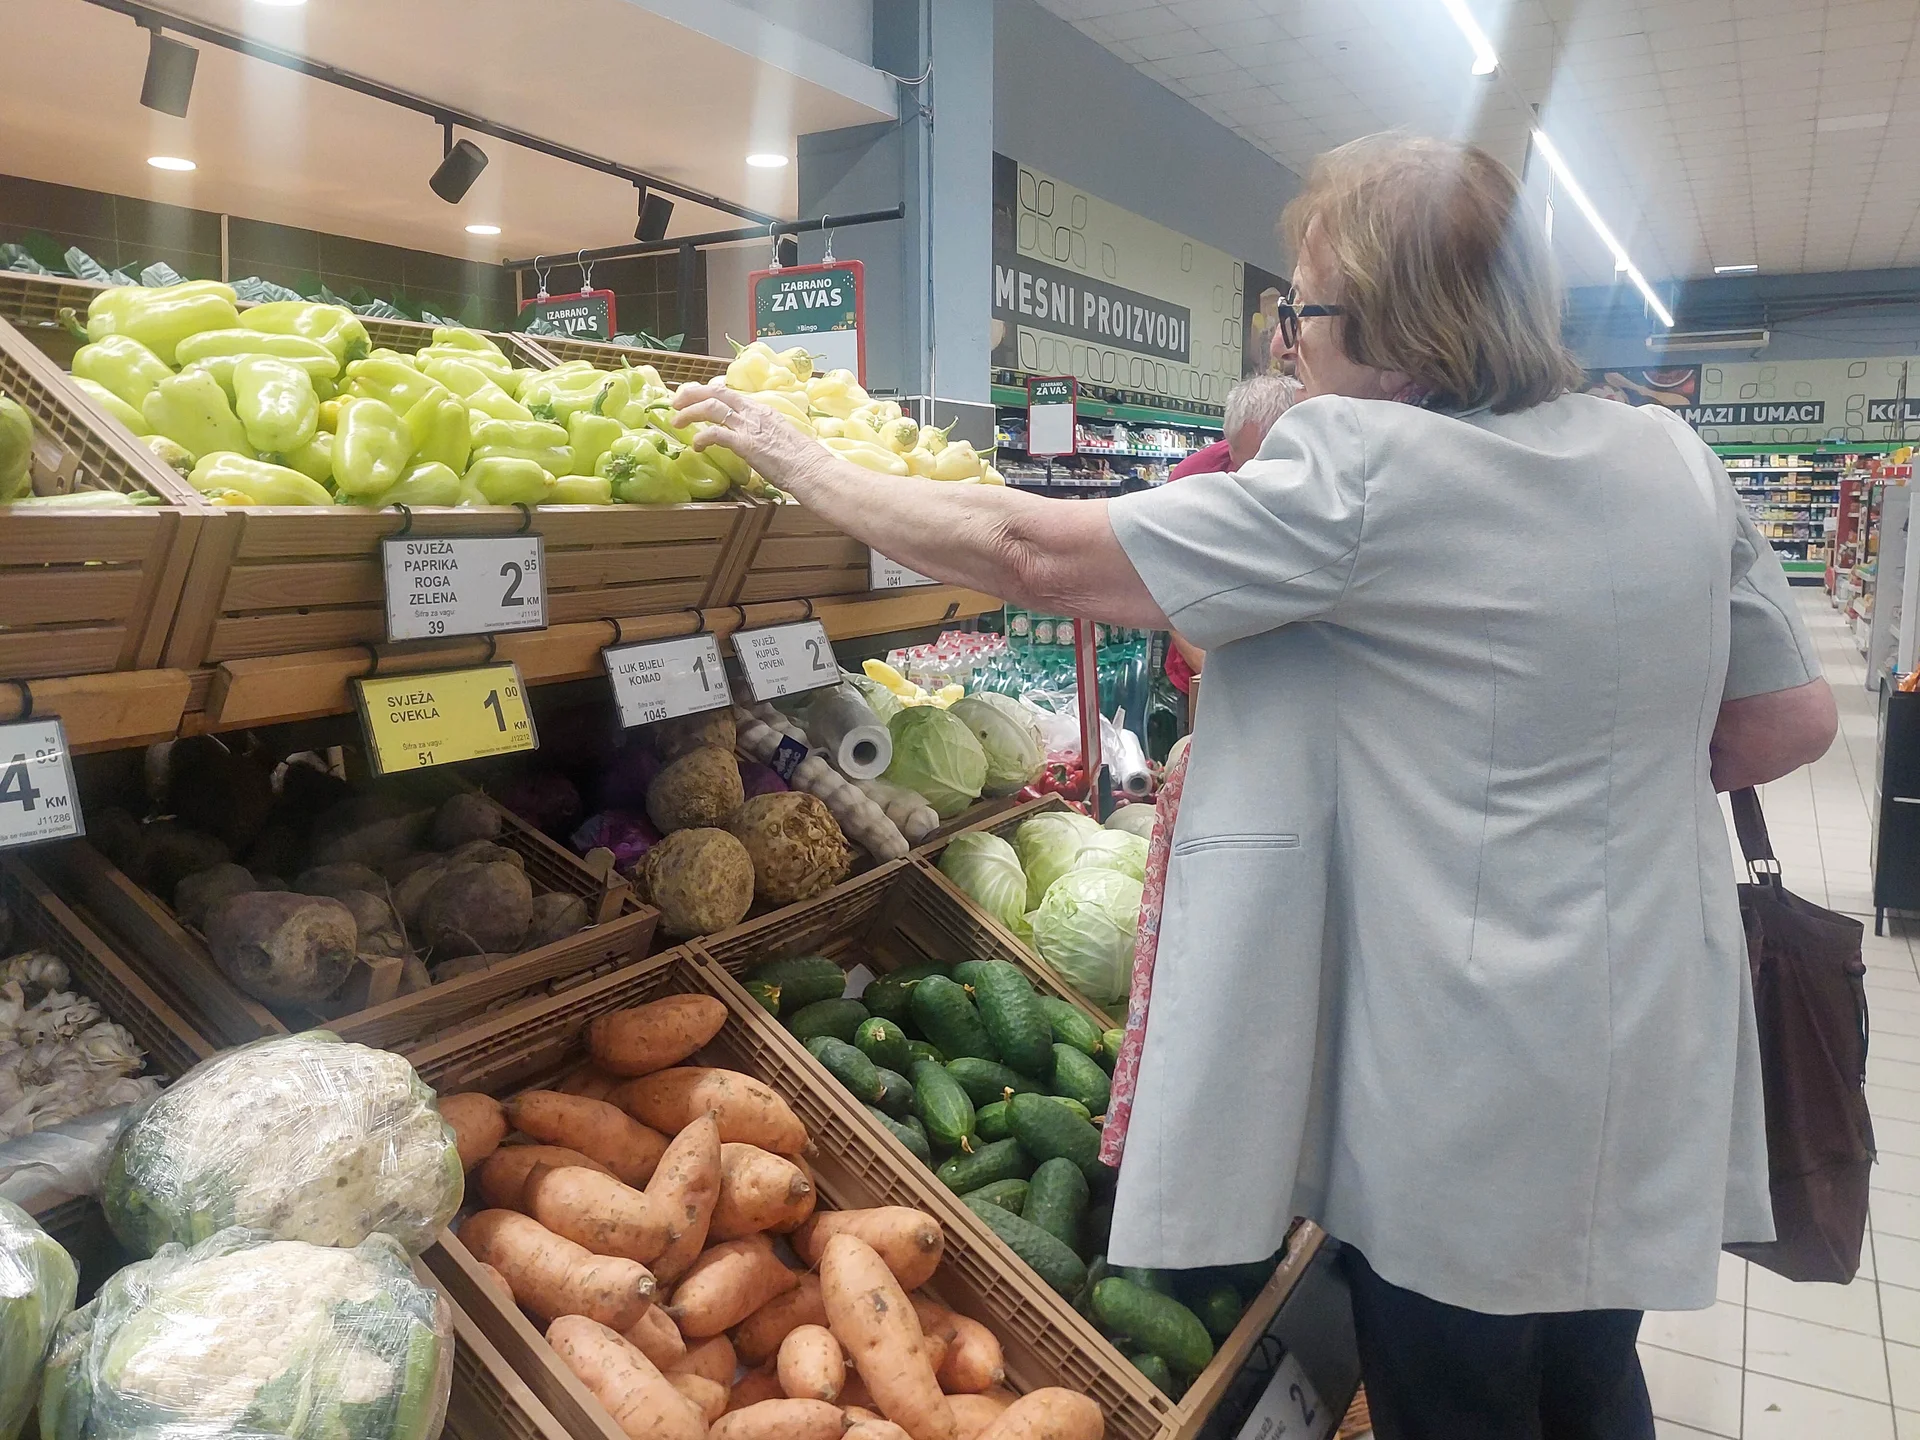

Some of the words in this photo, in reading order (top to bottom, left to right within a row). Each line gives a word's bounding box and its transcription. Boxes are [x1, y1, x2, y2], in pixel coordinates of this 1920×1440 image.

[781, 278, 832, 292] IZABRANO
[771, 292, 799, 312] ZA
[801, 288, 842, 309] VAS
[546, 307, 589, 320] IZABRANO
[995, 264, 1075, 327] MESNI
[1083, 291, 1186, 353] PROIZVODI
[564, 316, 598, 334] VAS
[1036, 387, 1048, 395] ZA
[1050, 386, 1067, 395] VAS
[1741, 407, 1746, 422] I
[1753, 405, 1820, 422] UMACI
[407, 540, 454, 555] SVJEŽA
[405, 559, 458, 572] PAPRIKA
[524, 560, 537, 571] 95
[415, 576, 450, 588] ROGA
[500, 562, 524, 607] 2
[886, 576, 901, 586] 1041
[409, 592, 457, 605] ZELENA
[527, 597, 539, 605] KM
[428, 621, 445, 635] 39
[751, 634, 776, 648] SVJEŽI
[755, 647, 780, 659] KUPUS
[805, 639, 826, 671] 2
[817, 636, 826, 645] 20
[619, 662, 637, 674] LUK
[638, 658, 665, 671] BIJELI
[758, 659, 785, 671] CRVENI
[629, 672, 661, 686] KOMAD
[692, 656, 710, 692] 1
[707, 653, 716, 663] 50
[776, 684, 787, 695] 46
[387, 690, 435, 708] SVJEŽA
[390, 707, 440, 724] CVEKLA
[484, 689, 507, 732] 1
[505, 686, 518, 698] 00
[514, 720, 528, 730] KM
[643, 707, 667, 722] 1045
[45, 736, 55, 744] kg
[510, 734, 530, 743] J12212
[36, 748, 58, 764] 95
[418, 751, 434, 765] 51
[0, 753, 41, 811] 4
[45, 796, 68, 809] KM
[37, 813, 71, 826] J11286
[1289, 1383, 1315, 1427] 2
